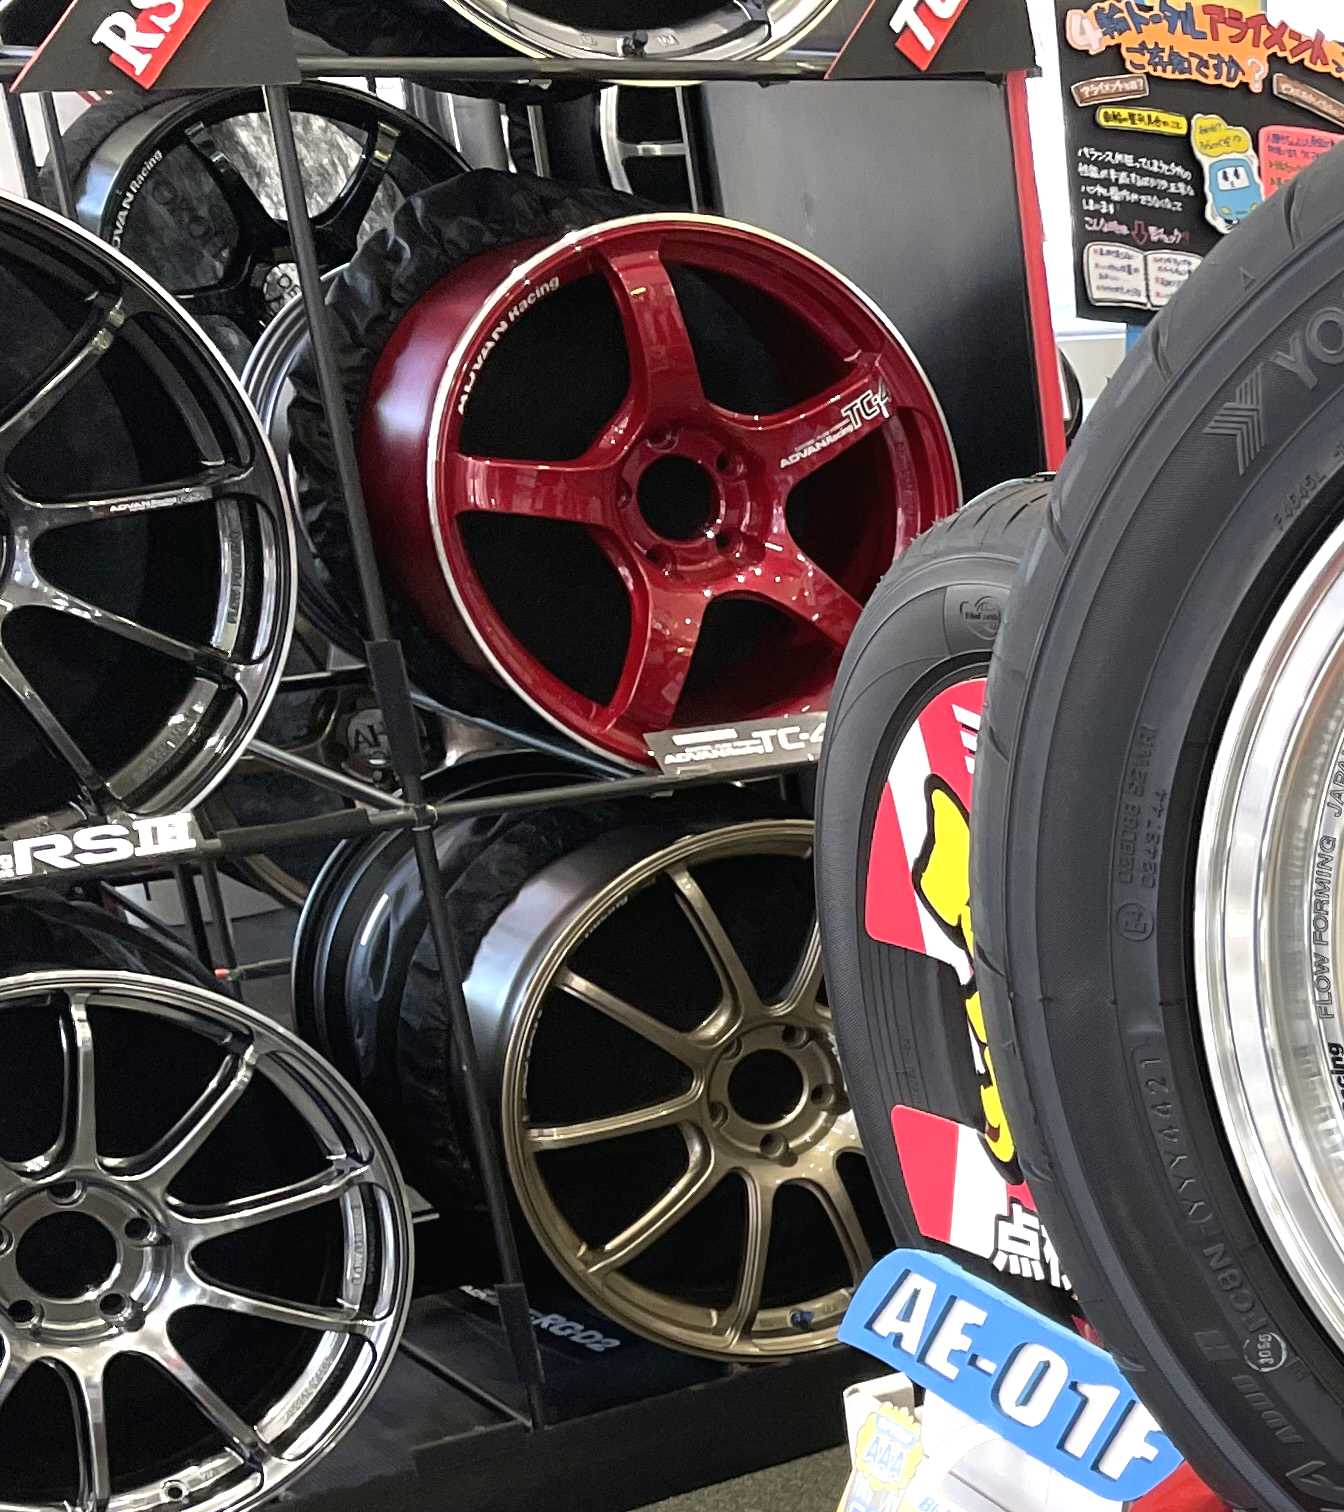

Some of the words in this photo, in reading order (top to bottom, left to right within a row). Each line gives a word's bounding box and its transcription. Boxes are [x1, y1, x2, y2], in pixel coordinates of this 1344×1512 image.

[112, 192, 136, 250] DVAN
[129, 150, 164, 193] Racing
[1313, 835, 1336, 947] FORMING
[1312, 953, 1336, 1020] FLOW
